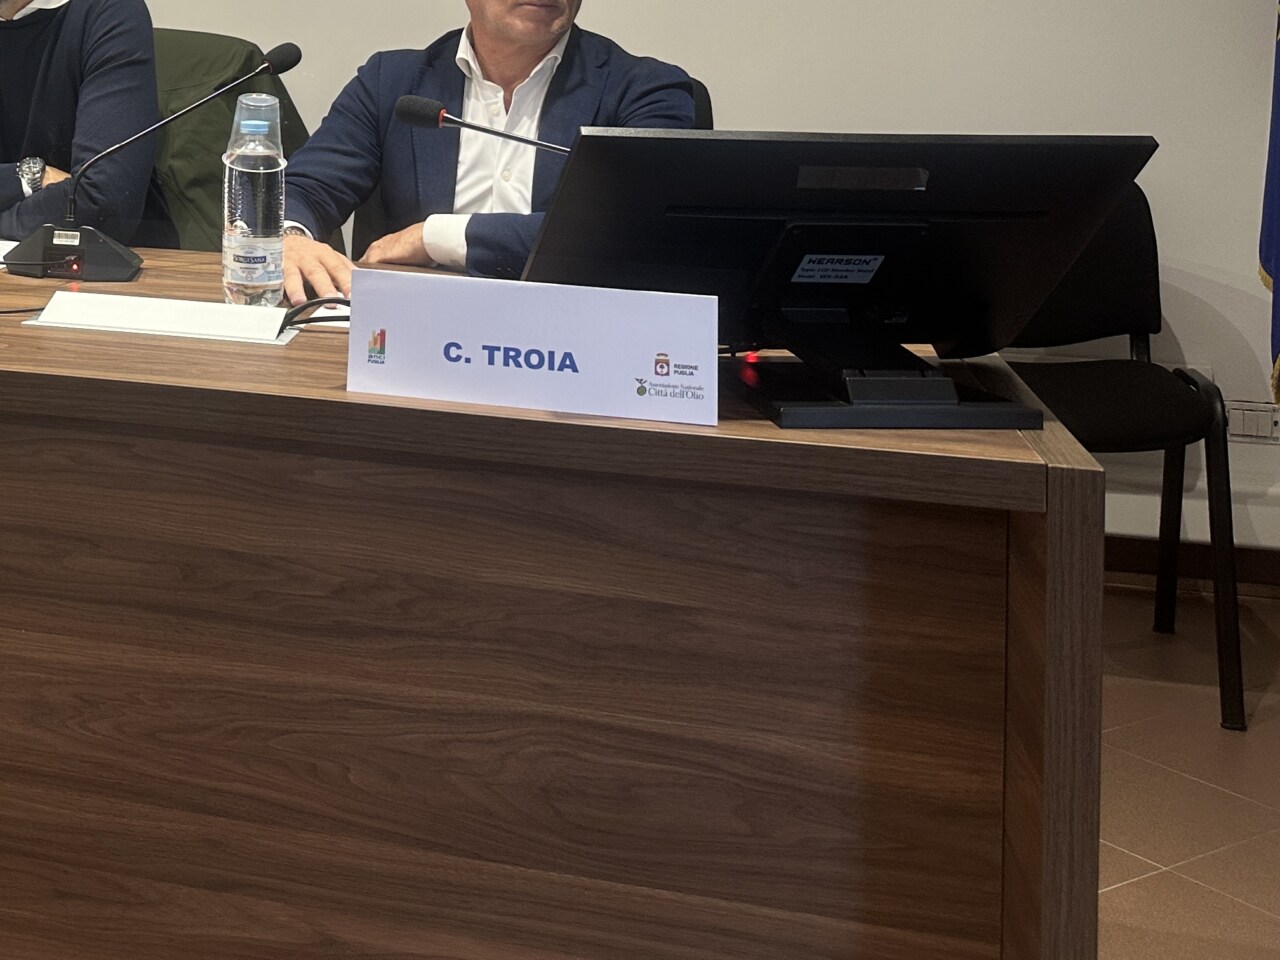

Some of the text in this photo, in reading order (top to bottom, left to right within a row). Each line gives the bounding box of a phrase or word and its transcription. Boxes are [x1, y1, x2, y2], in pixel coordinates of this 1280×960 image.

[443, 342, 579, 373] C. TROIA
[648, 387, 704, 400] Città dell'Olio
